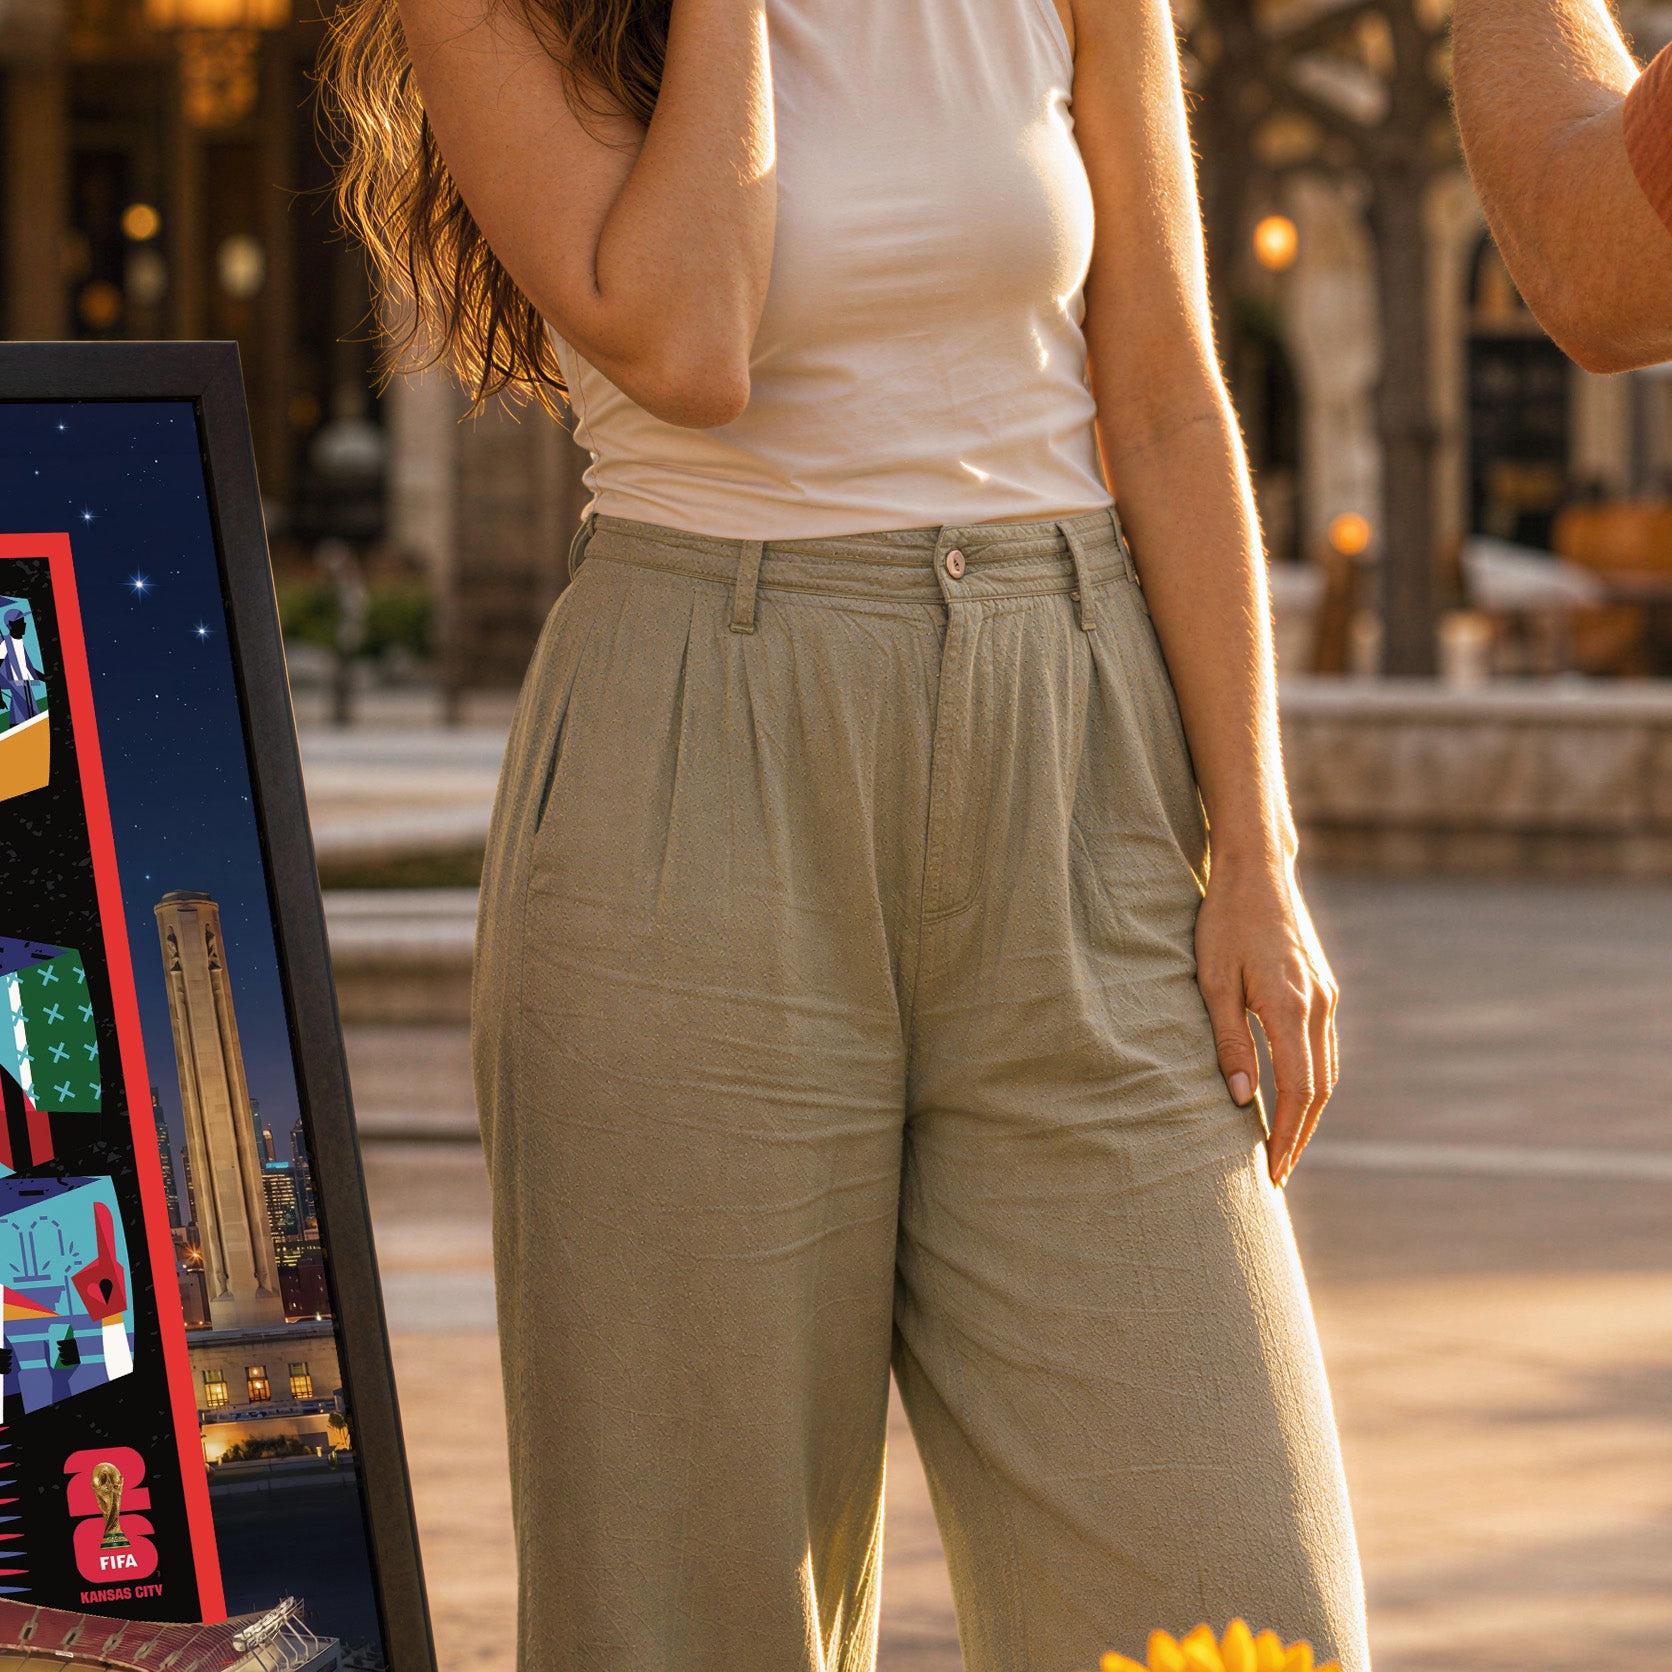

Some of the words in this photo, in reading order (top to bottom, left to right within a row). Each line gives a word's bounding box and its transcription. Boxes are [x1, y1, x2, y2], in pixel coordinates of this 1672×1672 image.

[99, 1553, 138, 1570] FIFA
[80, 1587, 132, 1604] KANSAS
[134, 1583, 163, 1599] CITY
